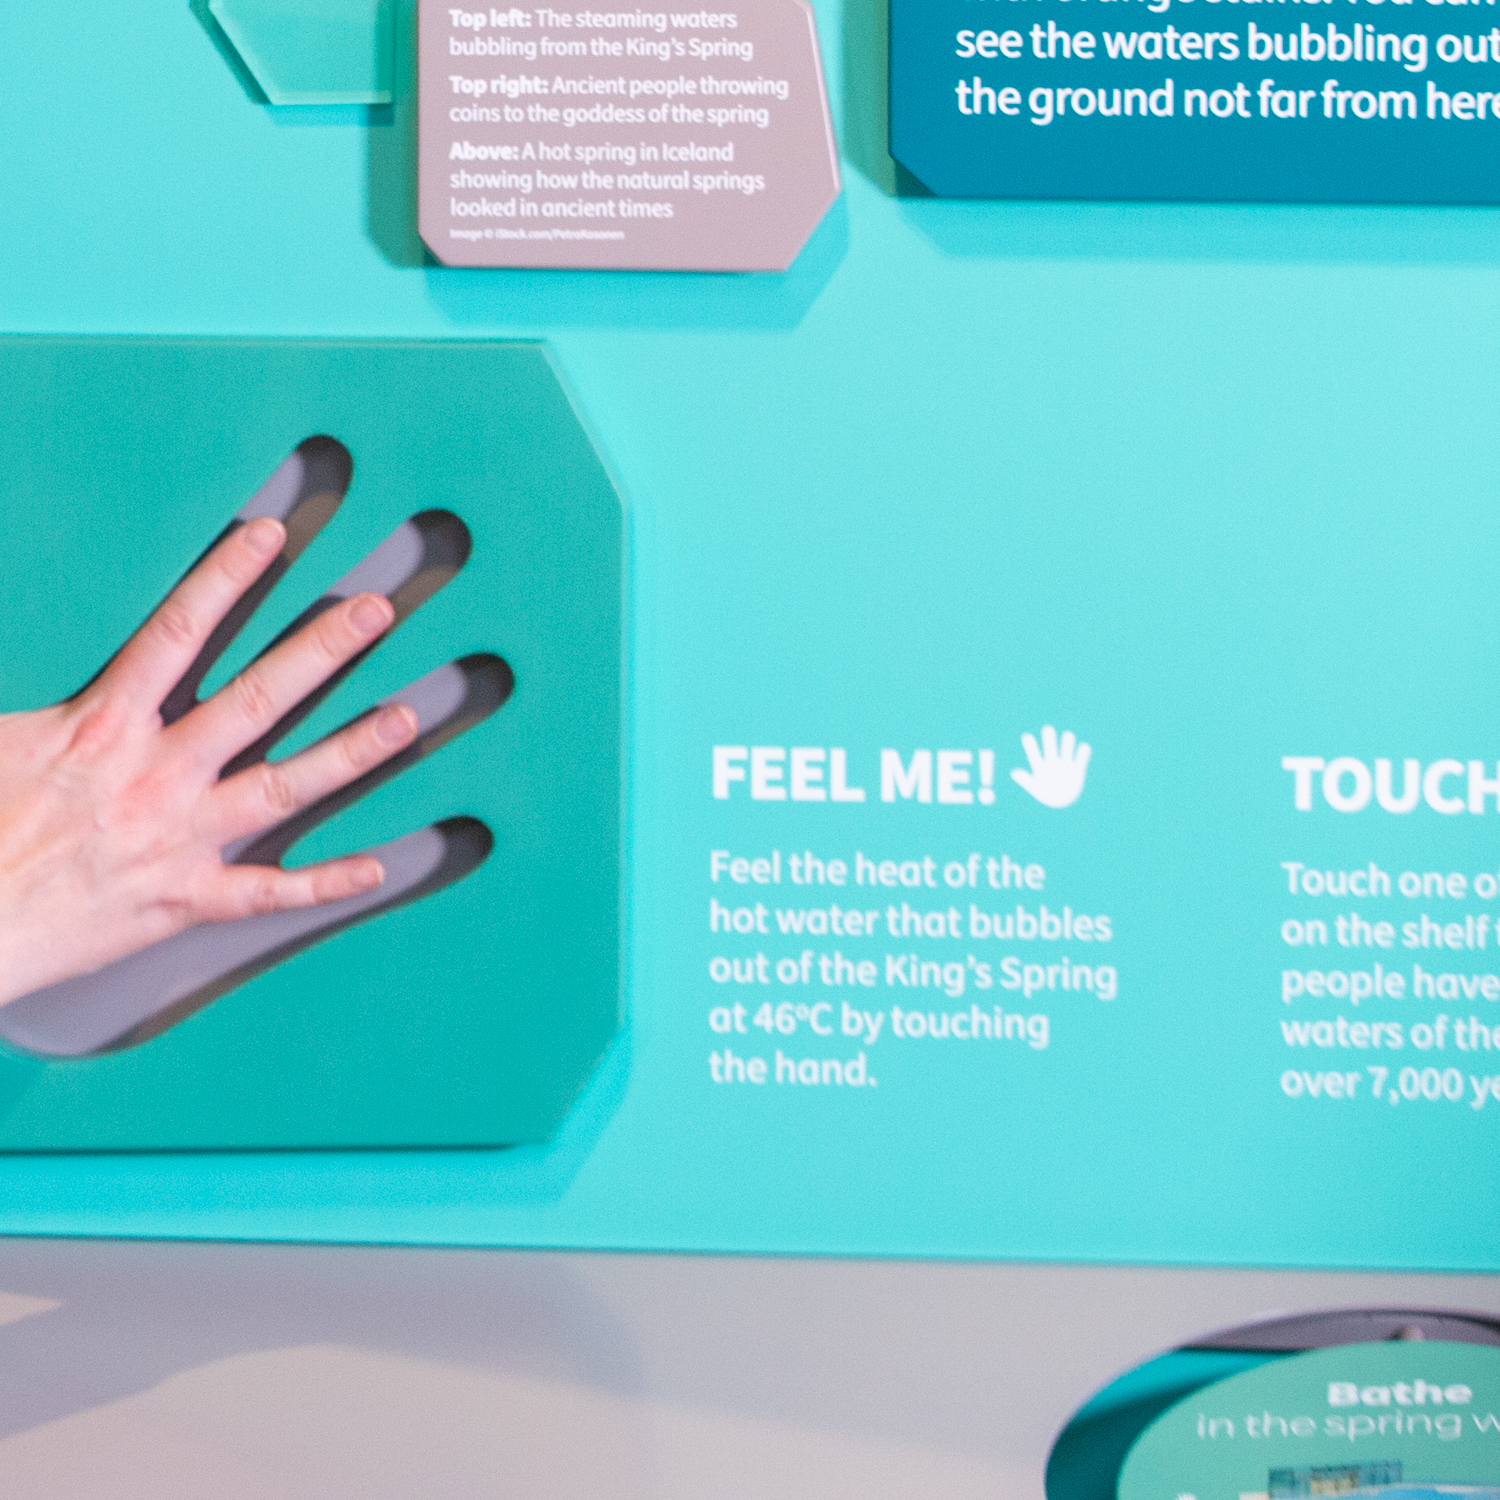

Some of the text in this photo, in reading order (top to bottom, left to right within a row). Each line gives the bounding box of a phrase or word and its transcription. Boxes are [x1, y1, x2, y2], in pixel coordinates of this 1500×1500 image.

[449, 8, 737, 33] Top left: The steaming waters
[449, 37, 537, 60] bubbling
[540, 36, 587, 56] from
[590, 37, 623, 56] the
[689, 38, 753, 61] Spring
[956, 20, 1500, 72] see the waters bubbling out
[449, 75, 789, 100] Top right: Ancient people throwing
[955, 77, 1021, 115] the
[1029, 78, 1174, 125] ground
[1185, 83, 1251, 117] not
[1258, 79, 1316, 118] far
[1321, 79, 1416, 119] from
[449, 103, 769, 128] coins to the goddess of the spring
[449, 141, 734, 166] Above: A hot spring in Iceland
[450, 169, 765, 195] showing how the natural springs
[451, 197, 673, 218] looked in ancient times
[713, 746, 995, 805] FEEL ME!
[1282, 756, 1500, 814] TOUCH
[711, 850, 1045, 890] Feel the heat of the
[1281, 862, 1391, 897] Touch
[1398, 871, 1467, 898] one
[710, 898, 1112, 941] hot water that bubbles
[1281, 919, 1327, 946] on
[1335, 912, 1395, 948] the
[1402, 914, 1490, 949] shelf
[709, 952, 769, 984] out
[776, 950, 814, 985] of
[818, 951, 877, 986] the
[1000, 956, 1117, 1000] Spring
[1282, 963, 1500, 1005] people have
[709, 1002, 747, 1033] at
[841, 1002, 884, 1044] by
[891, 1004, 1049, 1050] touching
[1280, 1016, 1404, 1049] waters
[1410, 1014, 1449, 1050] of
[709, 1049, 876, 1086] the hand.
[1280, 1070, 1361, 1098] over
[1367, 1066, 1464, 1105] 7,000
[1328, 1380, 1472, 1406] Bathe
[1198, 1414, 1234, 1438] in
[1246, 1412, 1316, 1437] the
[1325, 1410, 1462, 1442] spring
